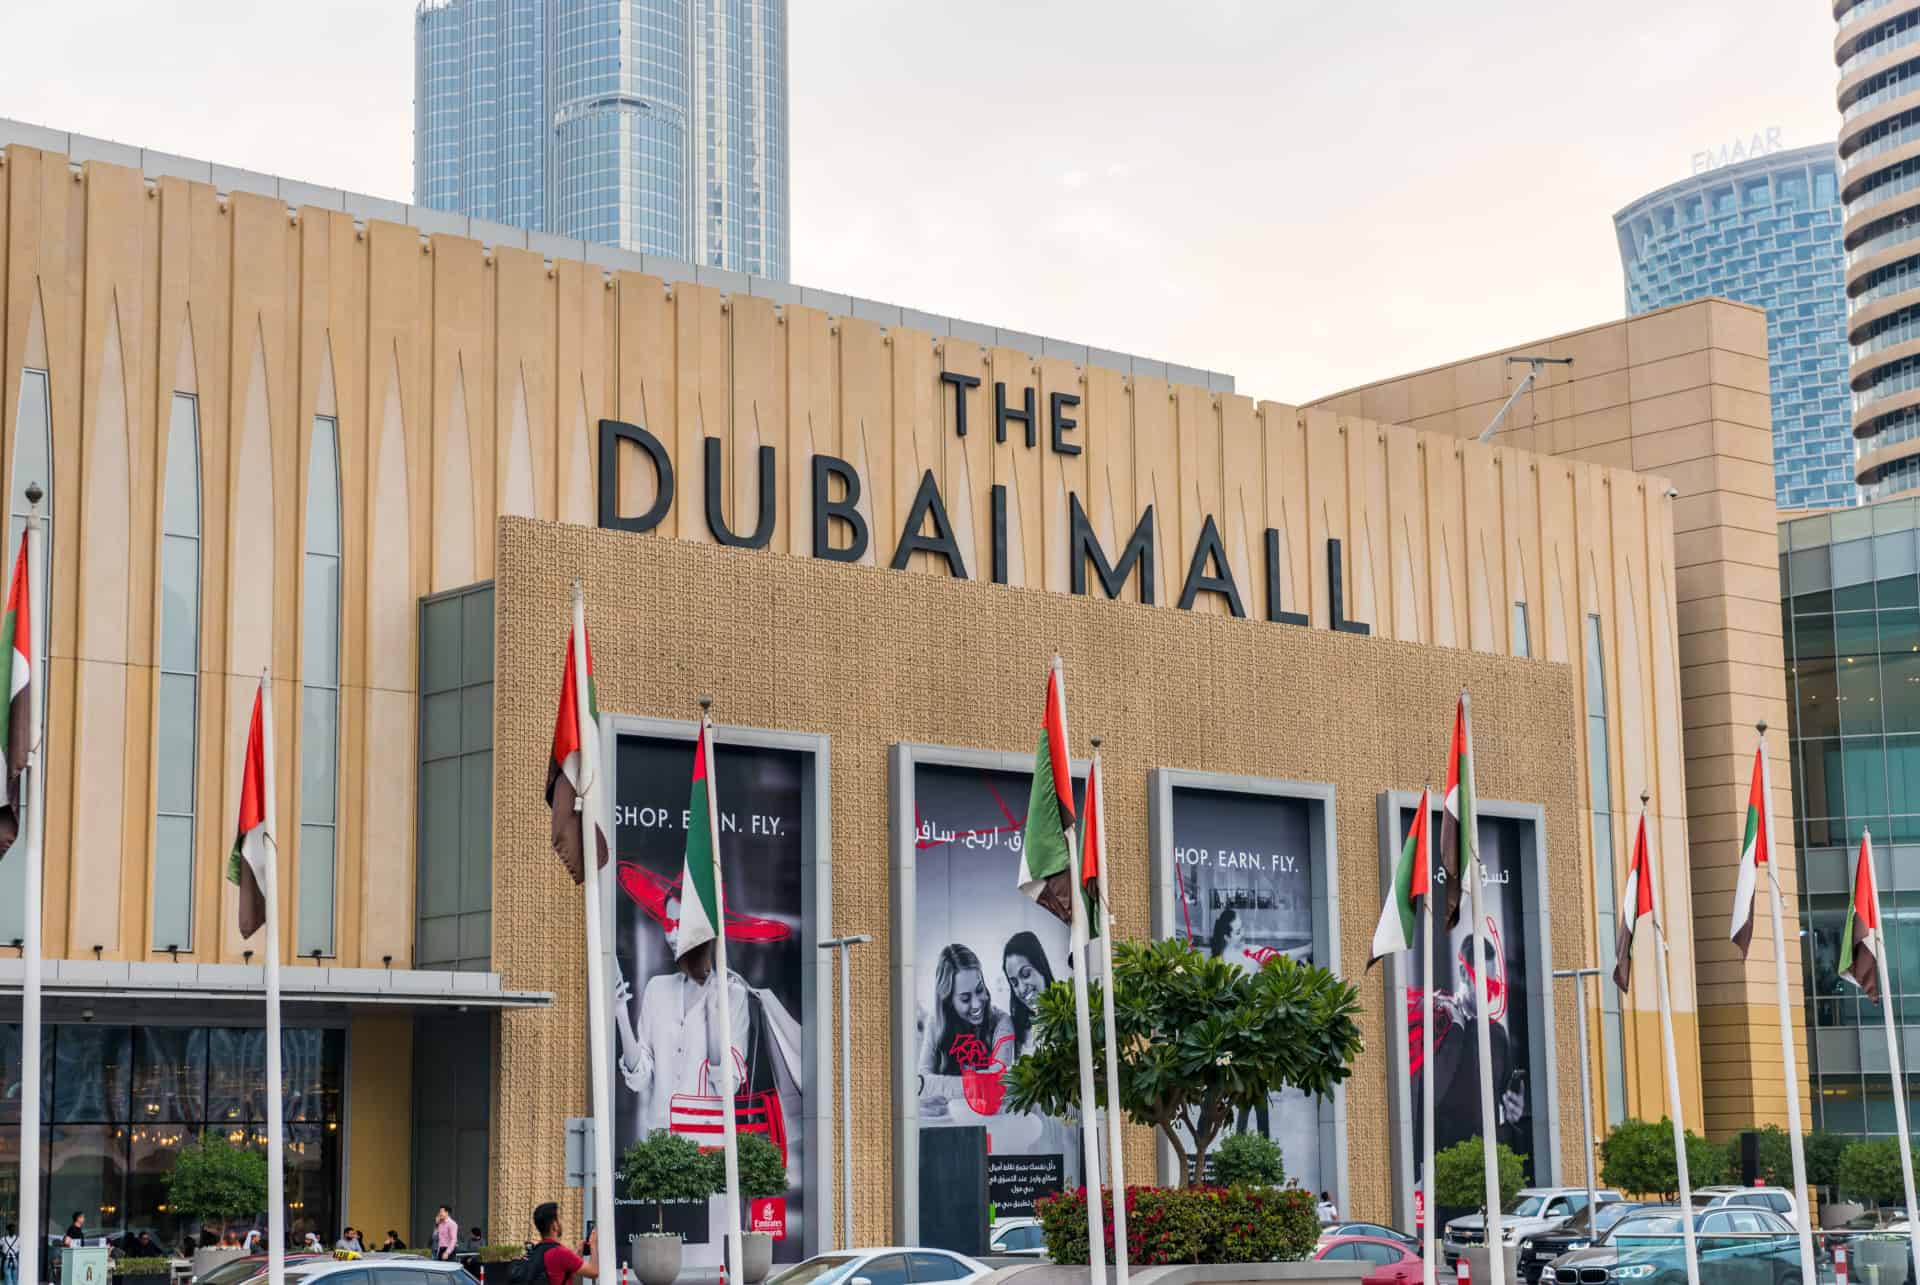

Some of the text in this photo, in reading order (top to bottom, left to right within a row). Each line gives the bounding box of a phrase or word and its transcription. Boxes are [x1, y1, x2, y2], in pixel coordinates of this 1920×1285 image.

[1691, 127, 1784, 174] EMAAR
[941, 371, 1082, 456] THE
[598, 418, 1370, 635] DUBAI MALL
[615, 805, 785, 836] SHOP. EN. FLY.
[1174, 847, 1299, 873] HOP. EARN. FLY.
